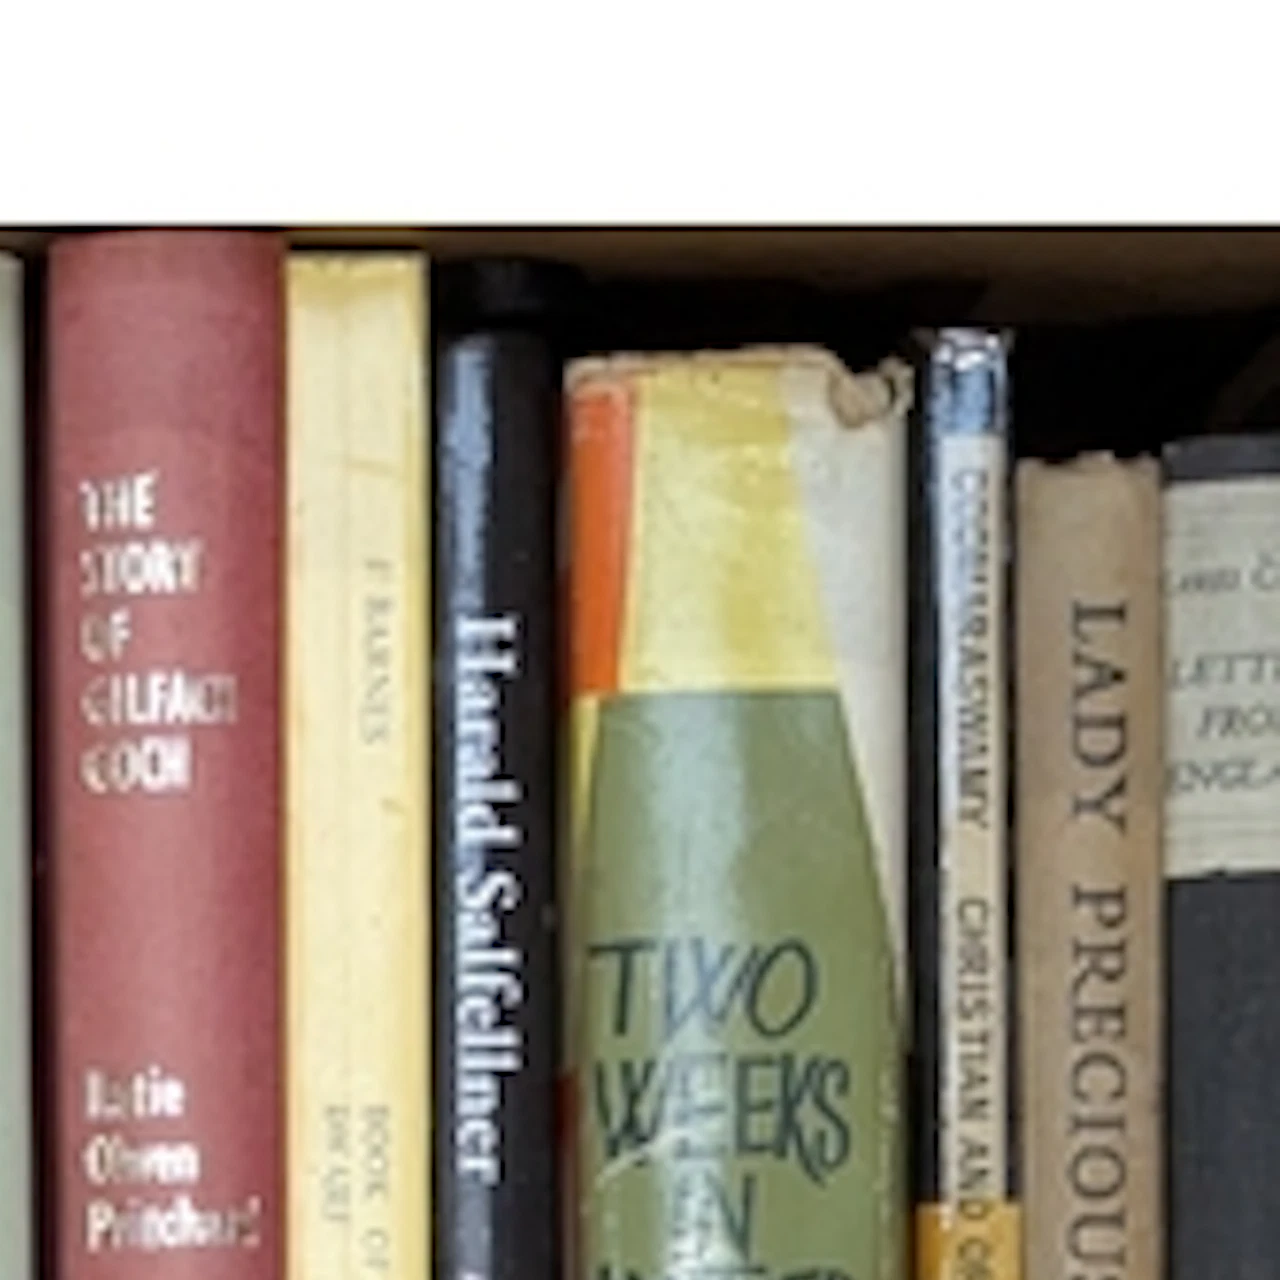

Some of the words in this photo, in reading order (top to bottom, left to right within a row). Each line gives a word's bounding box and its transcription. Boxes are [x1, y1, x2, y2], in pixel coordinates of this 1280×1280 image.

[455, 613, 523, 862] Harald
[1070, 601, 1129, 832] LADY
[455, 869, 524, 1186] Salfellner
[586, 936, 820, 1040] TWO
[955, 898, 991, 1116] CHRISTIAN
[594, 1051, 853, 1188] WEEKS
[955, 1126, 995, 1222] AND
